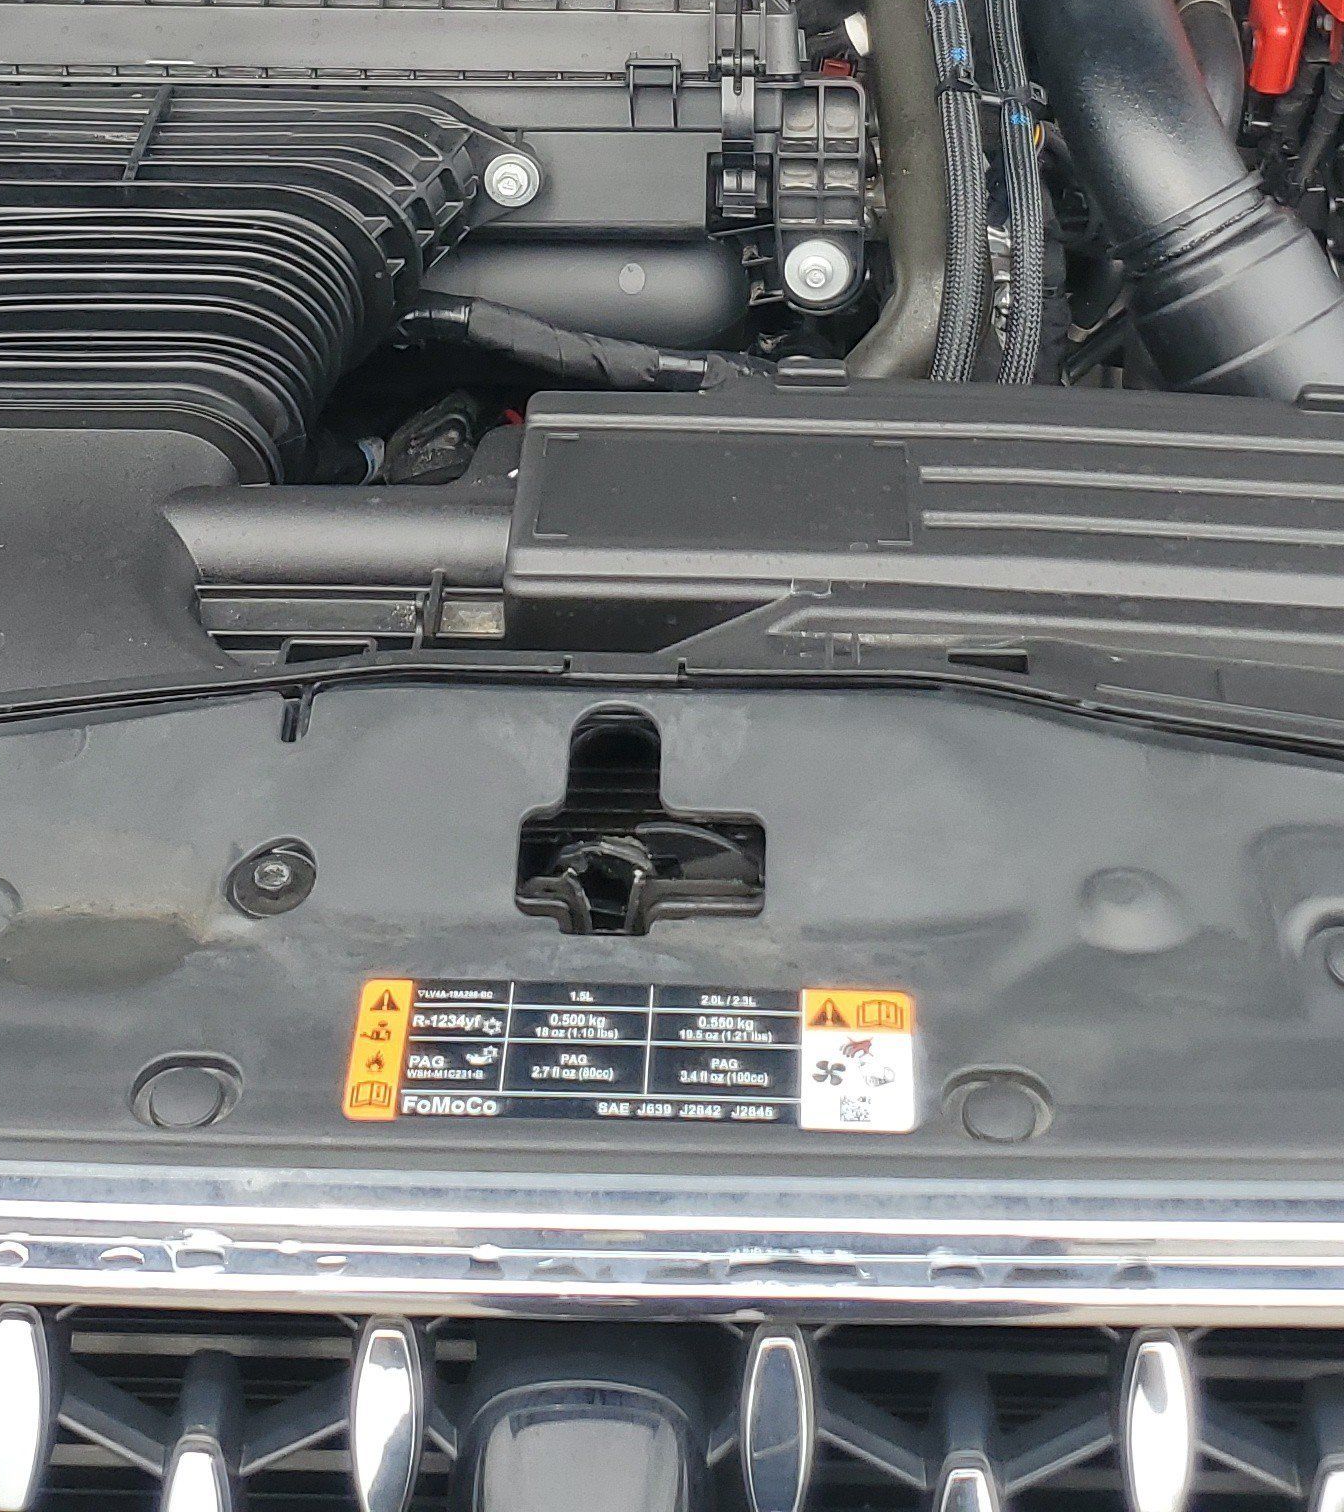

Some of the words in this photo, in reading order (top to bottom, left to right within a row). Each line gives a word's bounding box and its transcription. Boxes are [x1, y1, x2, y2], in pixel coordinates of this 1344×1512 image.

[569, 990, 594, 1002] 1.5L
[700, 994, 725, 1006] 2.0L
[412, 1014, 482, 1031] R-1234yf
[549, 1013, 586, 1026] 0.500
[588, 1014, 606, 1029] kg
[737, 1016, 754, 1031] kg
[535, 1026, 549, 1038] 18
[551, 1029, 566, 1038] oz
[567, 1027, 595, 1039] (1.10
[596, 1028, 619, 1040] lbs)
[705, 1032, 720, 1041] oz
[751, 1030, 773, 1044] lbs)
[408, 1054, 445, 1068] PAG
[560, 1053, 588, 1065] PAG
[711, 1058, 739, 1070] PAG
[531, 1066, 550, 1079] 2.7
[562, 1069, 577, 1079] oz
[710, 1073, 725, 1084] oz
[726, 1071, 769, 1087] (100cc)
[402, 1095, 498, 1116] FoMoCo
[597, 1102, 630, 1116] SAE
[636, 1103, 672, 1117] J639
